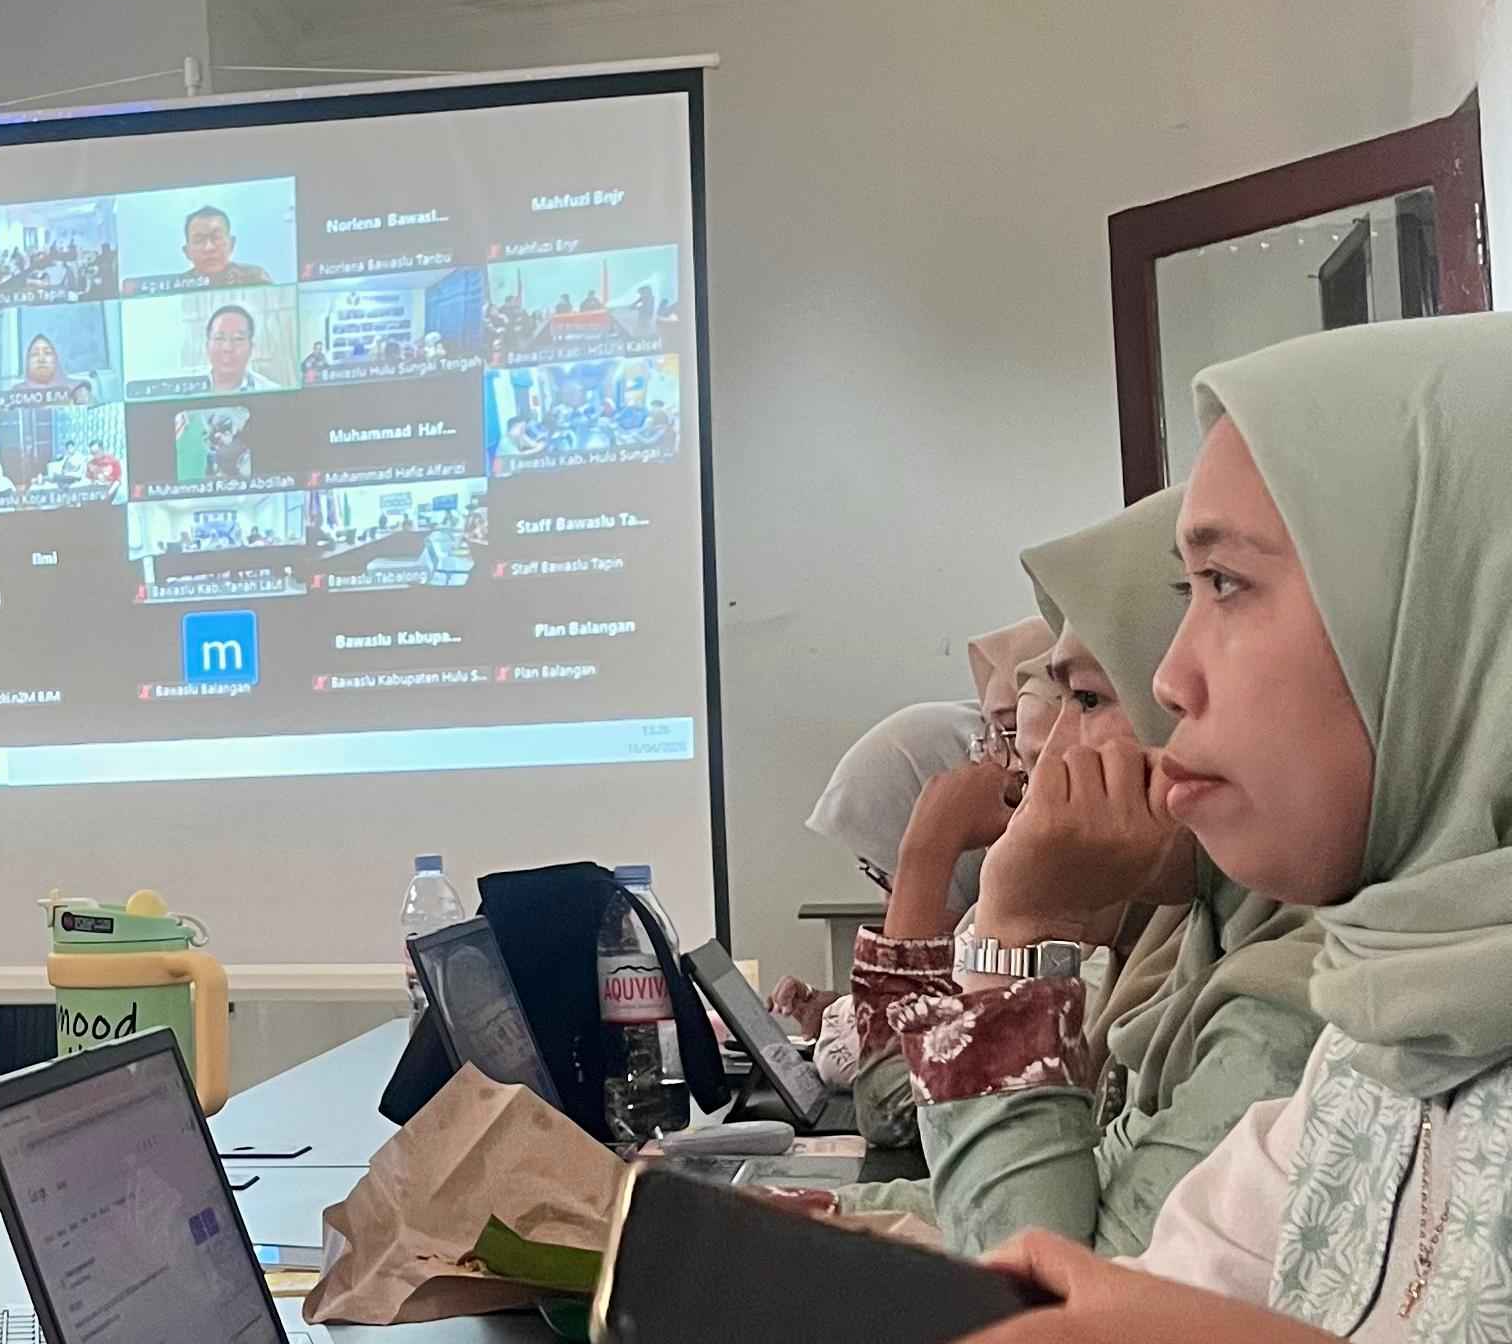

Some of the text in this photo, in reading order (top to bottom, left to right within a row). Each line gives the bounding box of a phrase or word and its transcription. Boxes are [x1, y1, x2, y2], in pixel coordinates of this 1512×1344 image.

[330, 424, 412, 443] Muhammad
[516, 518, 552, 534] Staff
[555, 514, 615, 532] Bawaslu
[511, 561, 538, 576] Staff
[535, 620, 635, 638] Plan Balangan
[335, 633, 392, 649] Bawaslu
[202, 639, 242, 671] m
[514, 664, 596, 680] Plan Balangan
[604, 977, 667, 1002] AQUVIV
